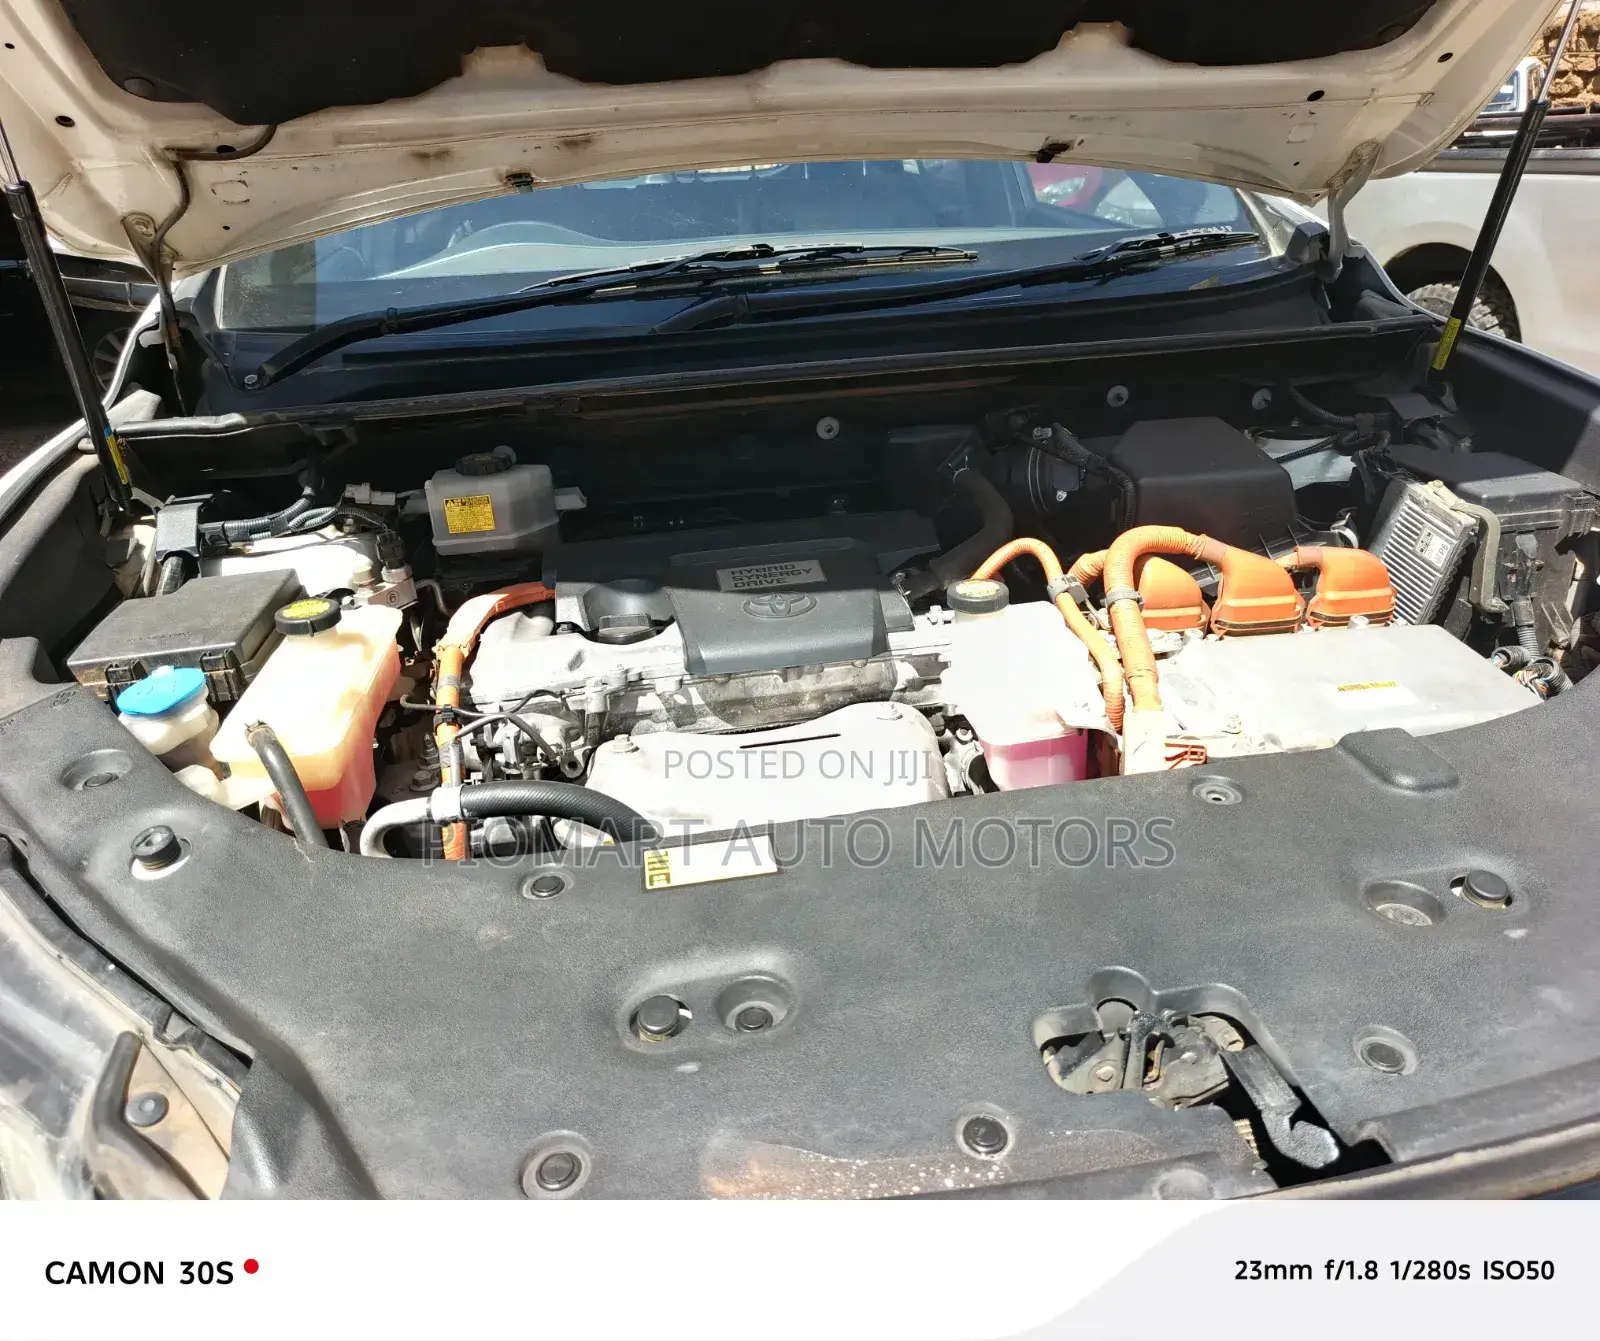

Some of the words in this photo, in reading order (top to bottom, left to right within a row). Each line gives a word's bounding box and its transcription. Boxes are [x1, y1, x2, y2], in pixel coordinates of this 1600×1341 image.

[730, 564, 796, 576] HYBRID
[731, 568, 813, 582] SYNERGY
[733, 577, 788, 589] DRIVE
